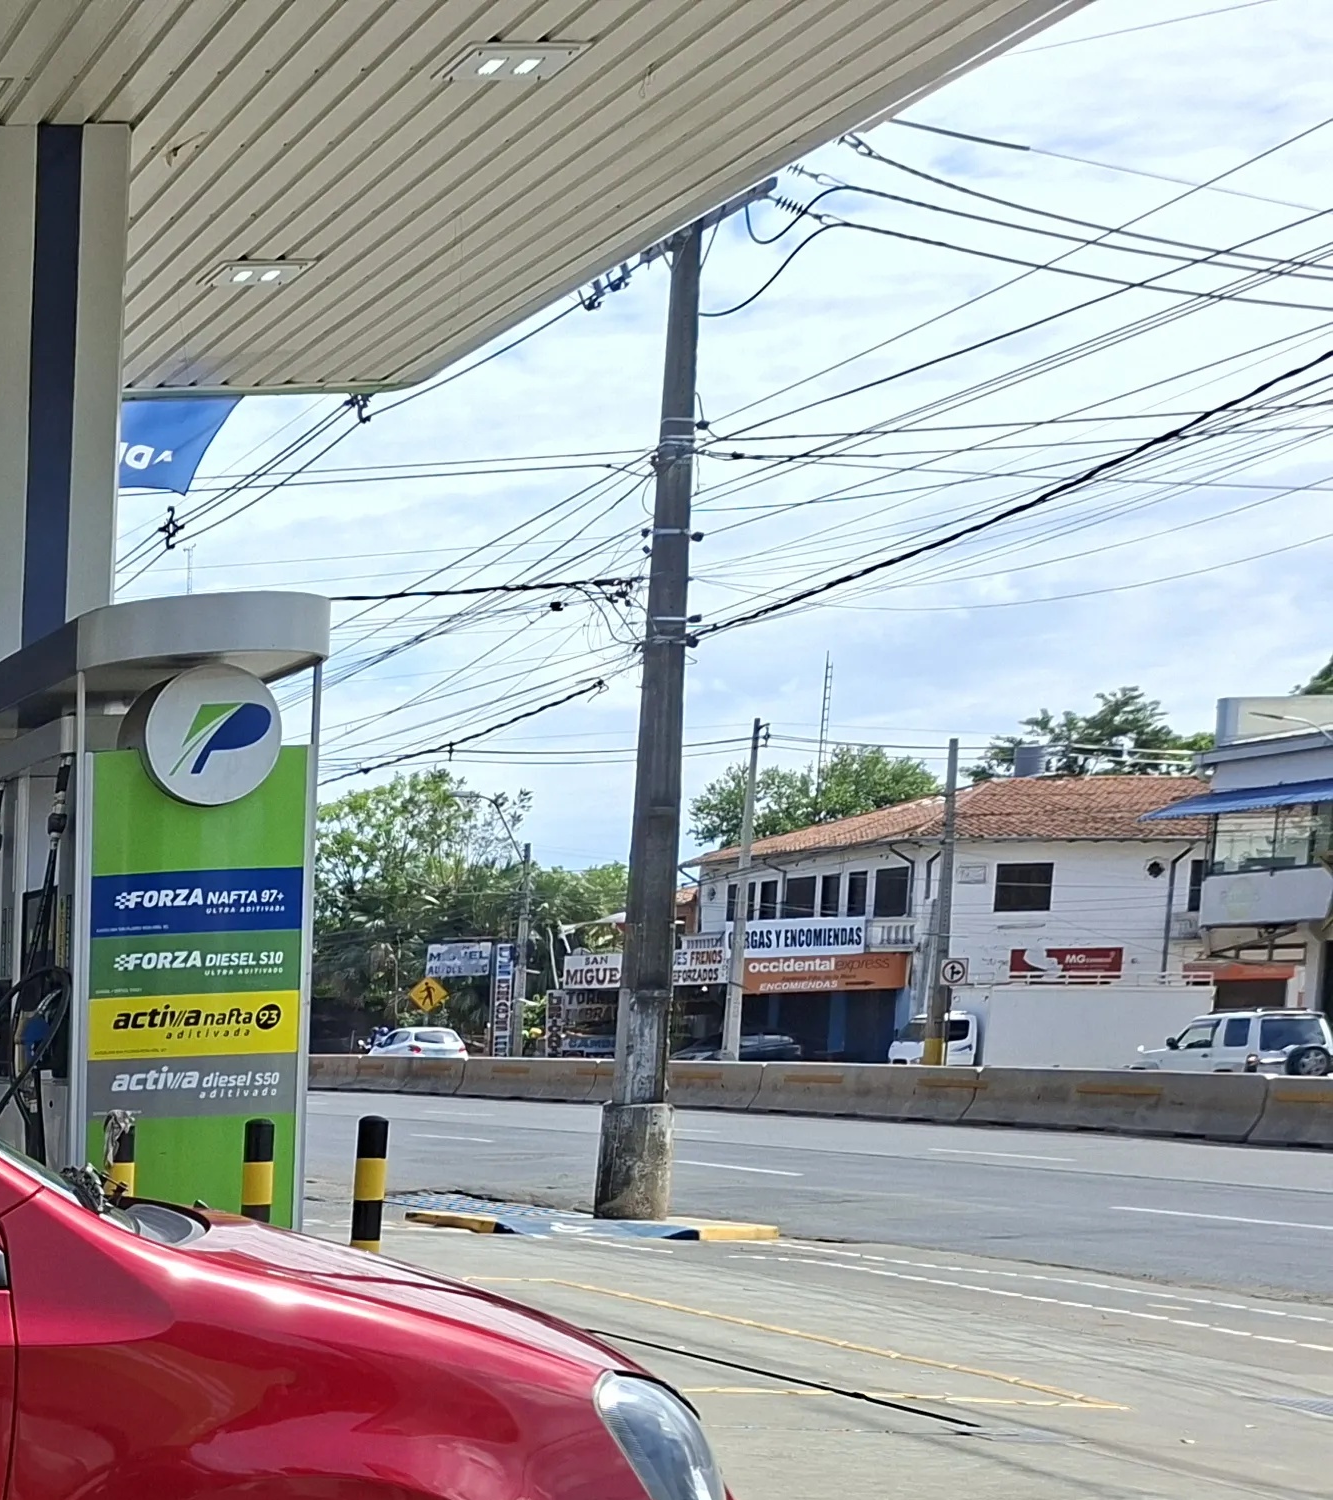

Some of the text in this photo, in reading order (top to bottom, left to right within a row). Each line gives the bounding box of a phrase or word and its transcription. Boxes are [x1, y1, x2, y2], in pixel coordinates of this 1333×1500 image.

[129, 888, 285, 909] FORZA NAFTA 97+
[206, 904, 285, 915] ULTRA ADITIVADA
[728, 926, 862, 949] CRGAS Y ENCOMIENDAS
[128, 951, 283, 971] FORZA DIESEL S10
[585, 956, 609, 966] SAN
[690, 950, 722, 966] FRENOS
[205, 966, 283, 977] ULTRA ADITIVADO
[565, 967, 621, 986] MIGUE
[673, 968, 719, 983] EFORZADOS
[759, 980, 838, 992] ENCOMIENDAS
[113, 1004, 278, 1030] activa nafta 93
[166, 1028, 250, 1039] aditivada
[111, 1066, 280, 1092] activa diesel S50
[199, 1088, 277, 1099] aditivado
